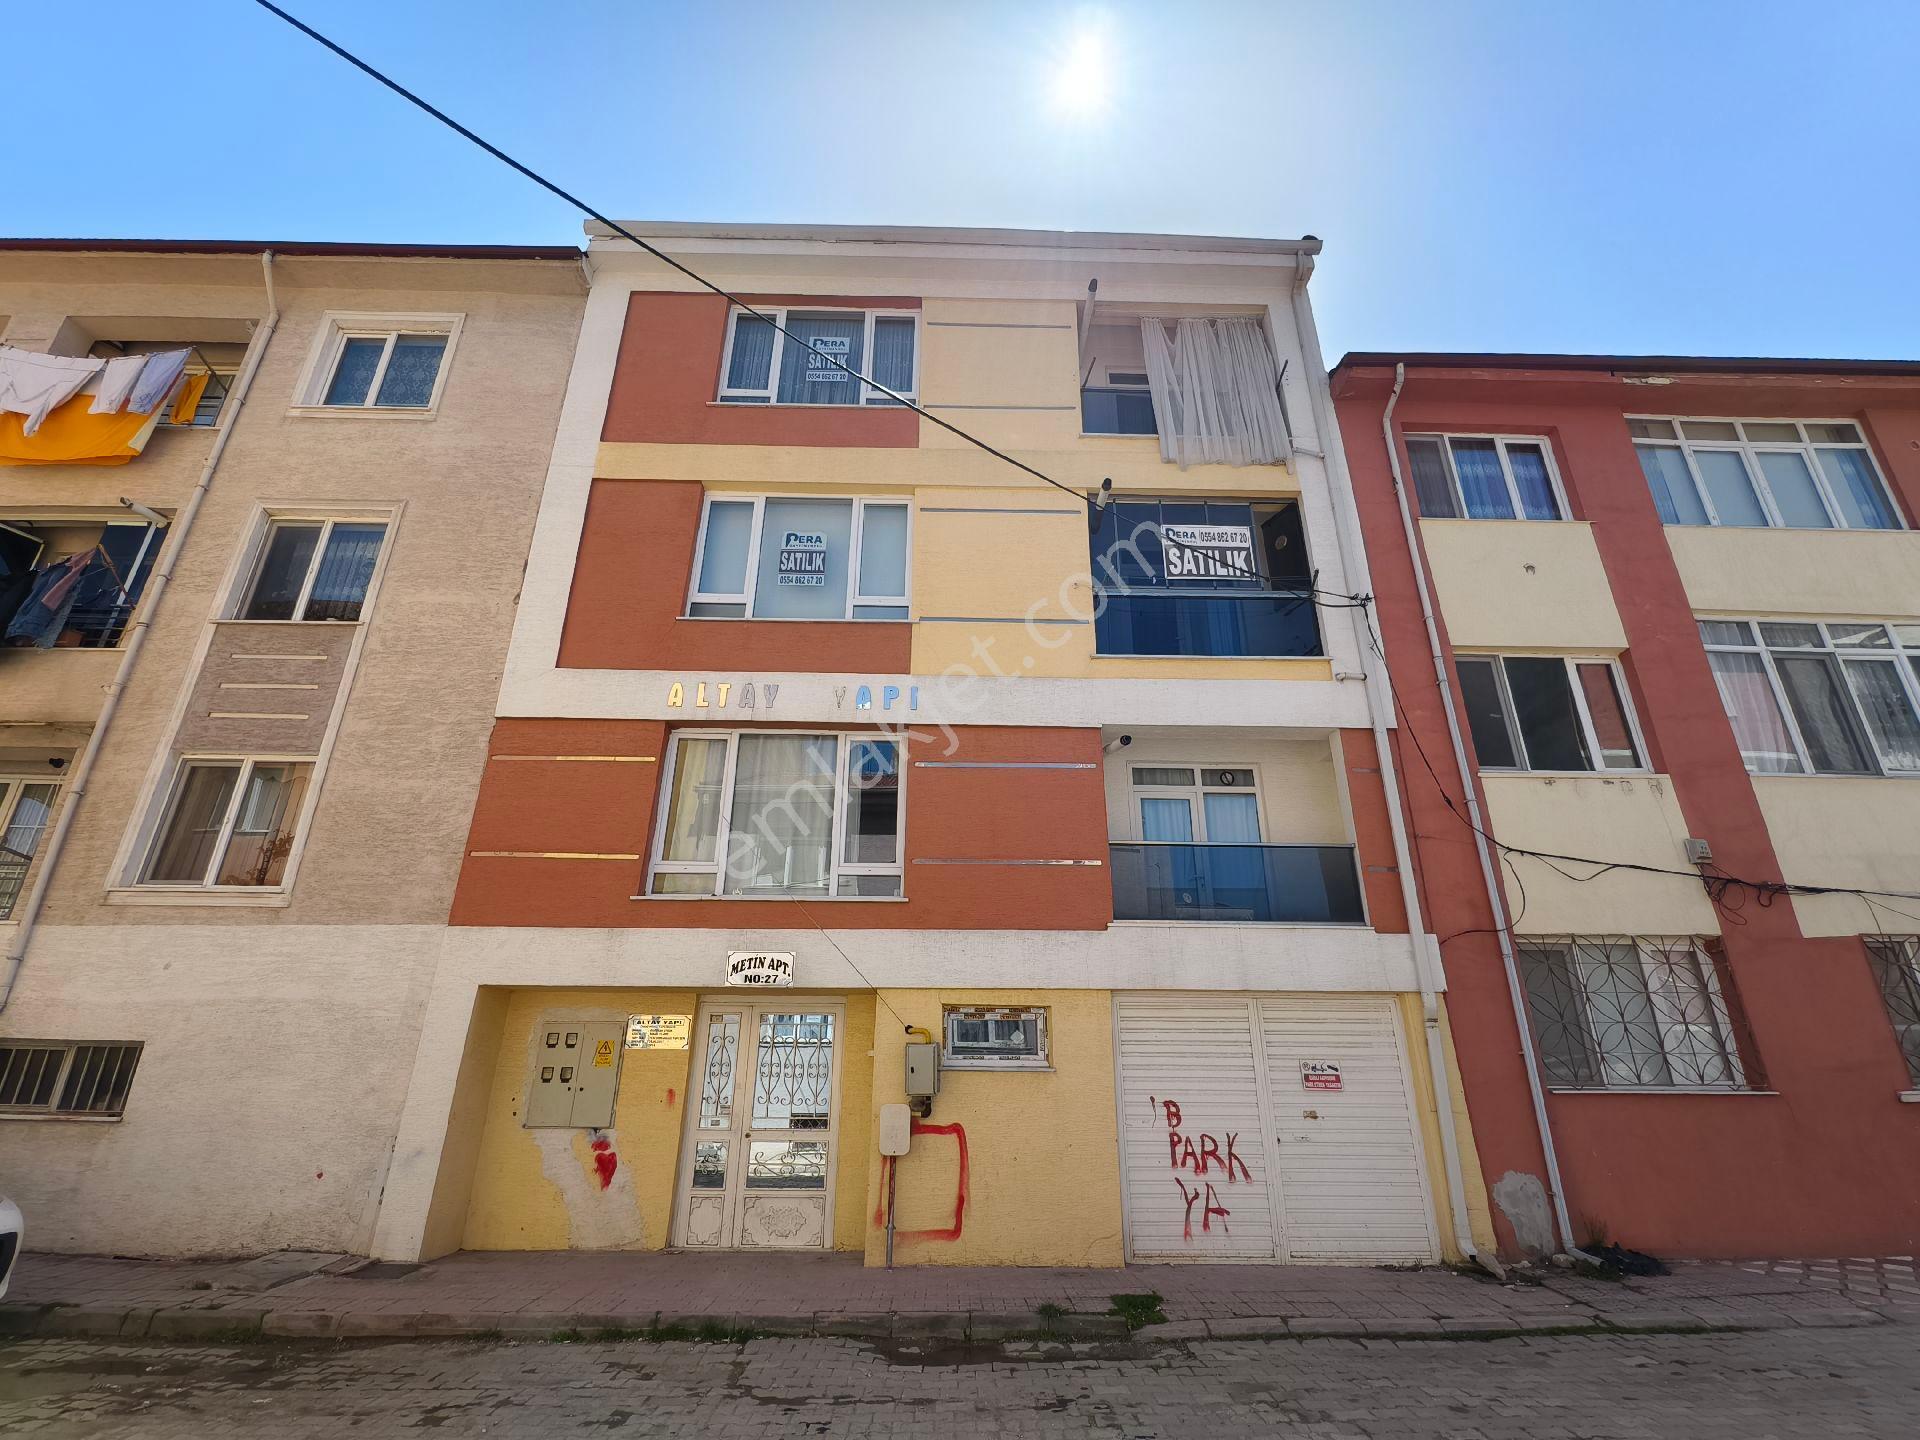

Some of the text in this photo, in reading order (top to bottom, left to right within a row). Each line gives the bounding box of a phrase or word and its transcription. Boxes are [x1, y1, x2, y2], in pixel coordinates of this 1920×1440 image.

[812, 338, 846, 348] PERA
[785, 533, 823, 547] PERA
[1200, 531, 1216, 542] 0554
[1239, 532, 1248, 544] 20
[780, 552, 825, 571] SATILIK
[1168, 547, 1251, 576] SATILIK
[667, 682, 919, 711] ALTAY YAPI
[767, 957, 791, 977] APT.
[744, 974, 779, 984] NO:27
[1168, 1131, 1253, 1184] PARK
[1174, 1176, 1231, 1242] YA
